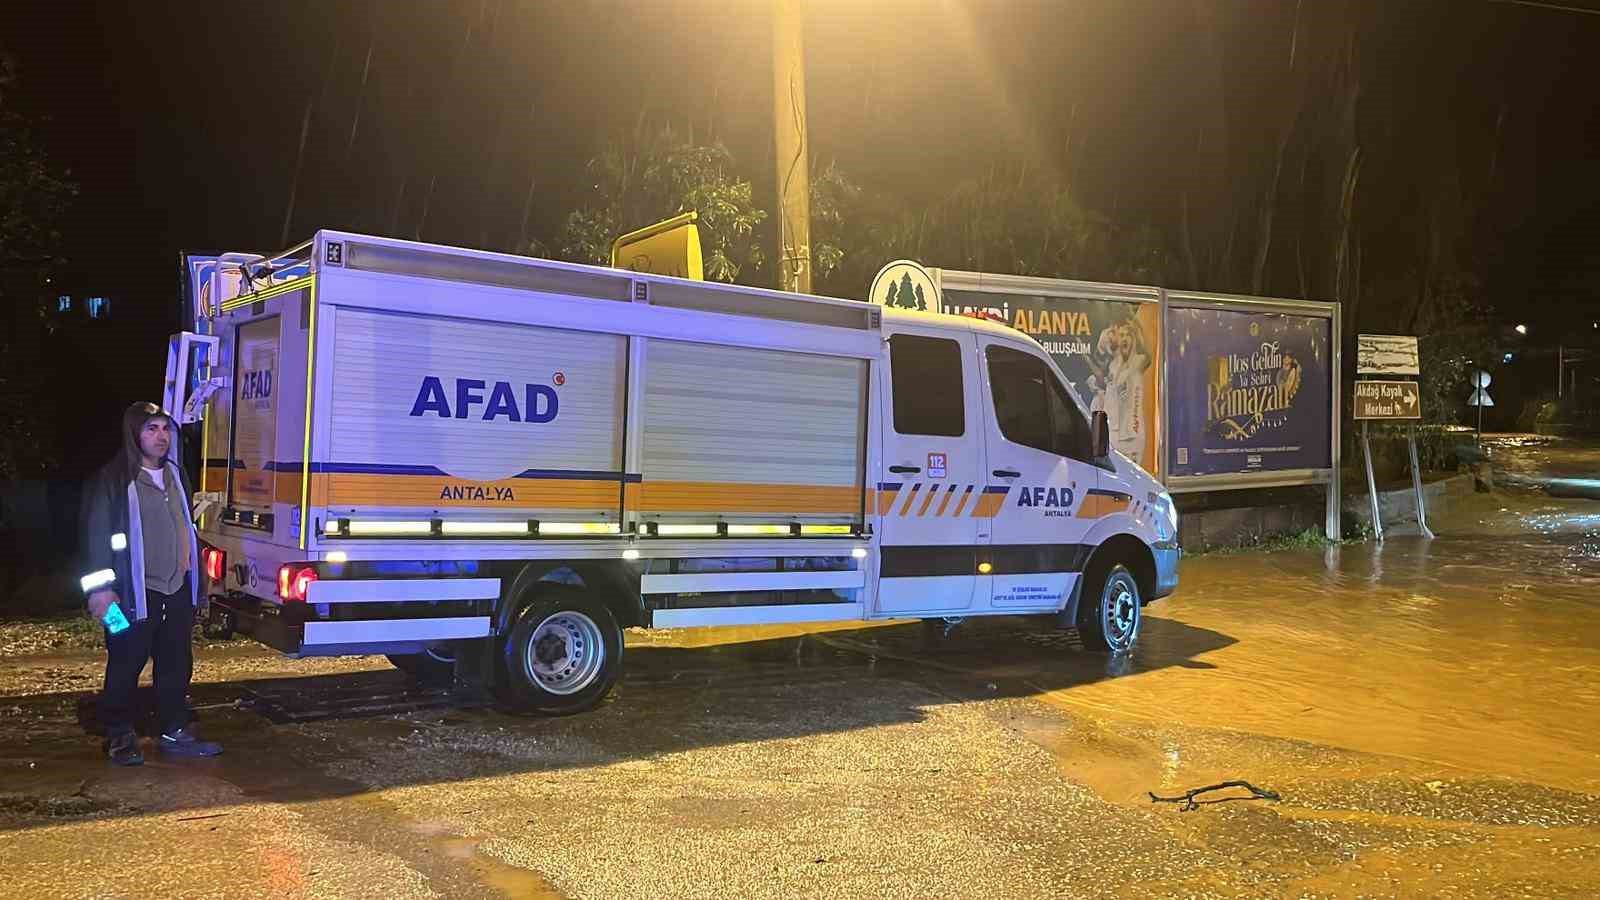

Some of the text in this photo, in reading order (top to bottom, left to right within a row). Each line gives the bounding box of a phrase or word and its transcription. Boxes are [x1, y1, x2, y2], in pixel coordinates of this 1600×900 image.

[1014, 309, 1092, 336] ALANYA
[1043, 342, 1091, 357] BULUŞALIM
[241, 370, 272, 400] AFAD
[1357, 383, 1403, 400] Akdağ Kayak
[409, 375, 559, 423] AFAD
[1364, 402, 1393, 416] Merkezi
[930, 456, 944, 468] 112
[440, 485, 514, 501] ANTALYA
[1017, 486, 1074, 507] AFAD
